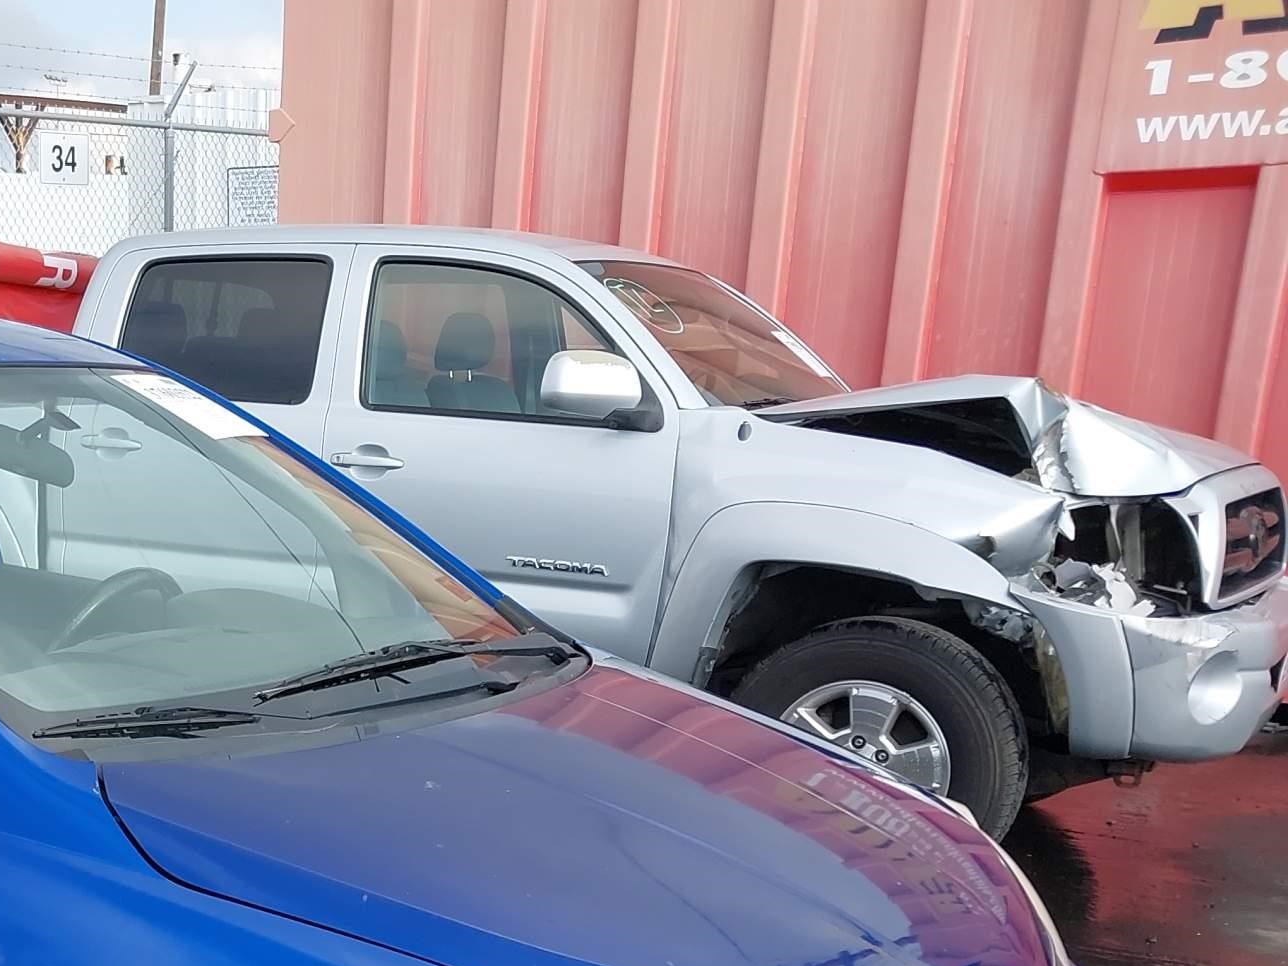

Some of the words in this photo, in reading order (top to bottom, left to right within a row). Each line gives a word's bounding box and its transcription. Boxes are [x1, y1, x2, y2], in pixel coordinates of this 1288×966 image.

[1144, 49, 1288, 95] 1-8
[51, 144, 77, 173] 34
[505, 555, 609, 577] TACOMA
